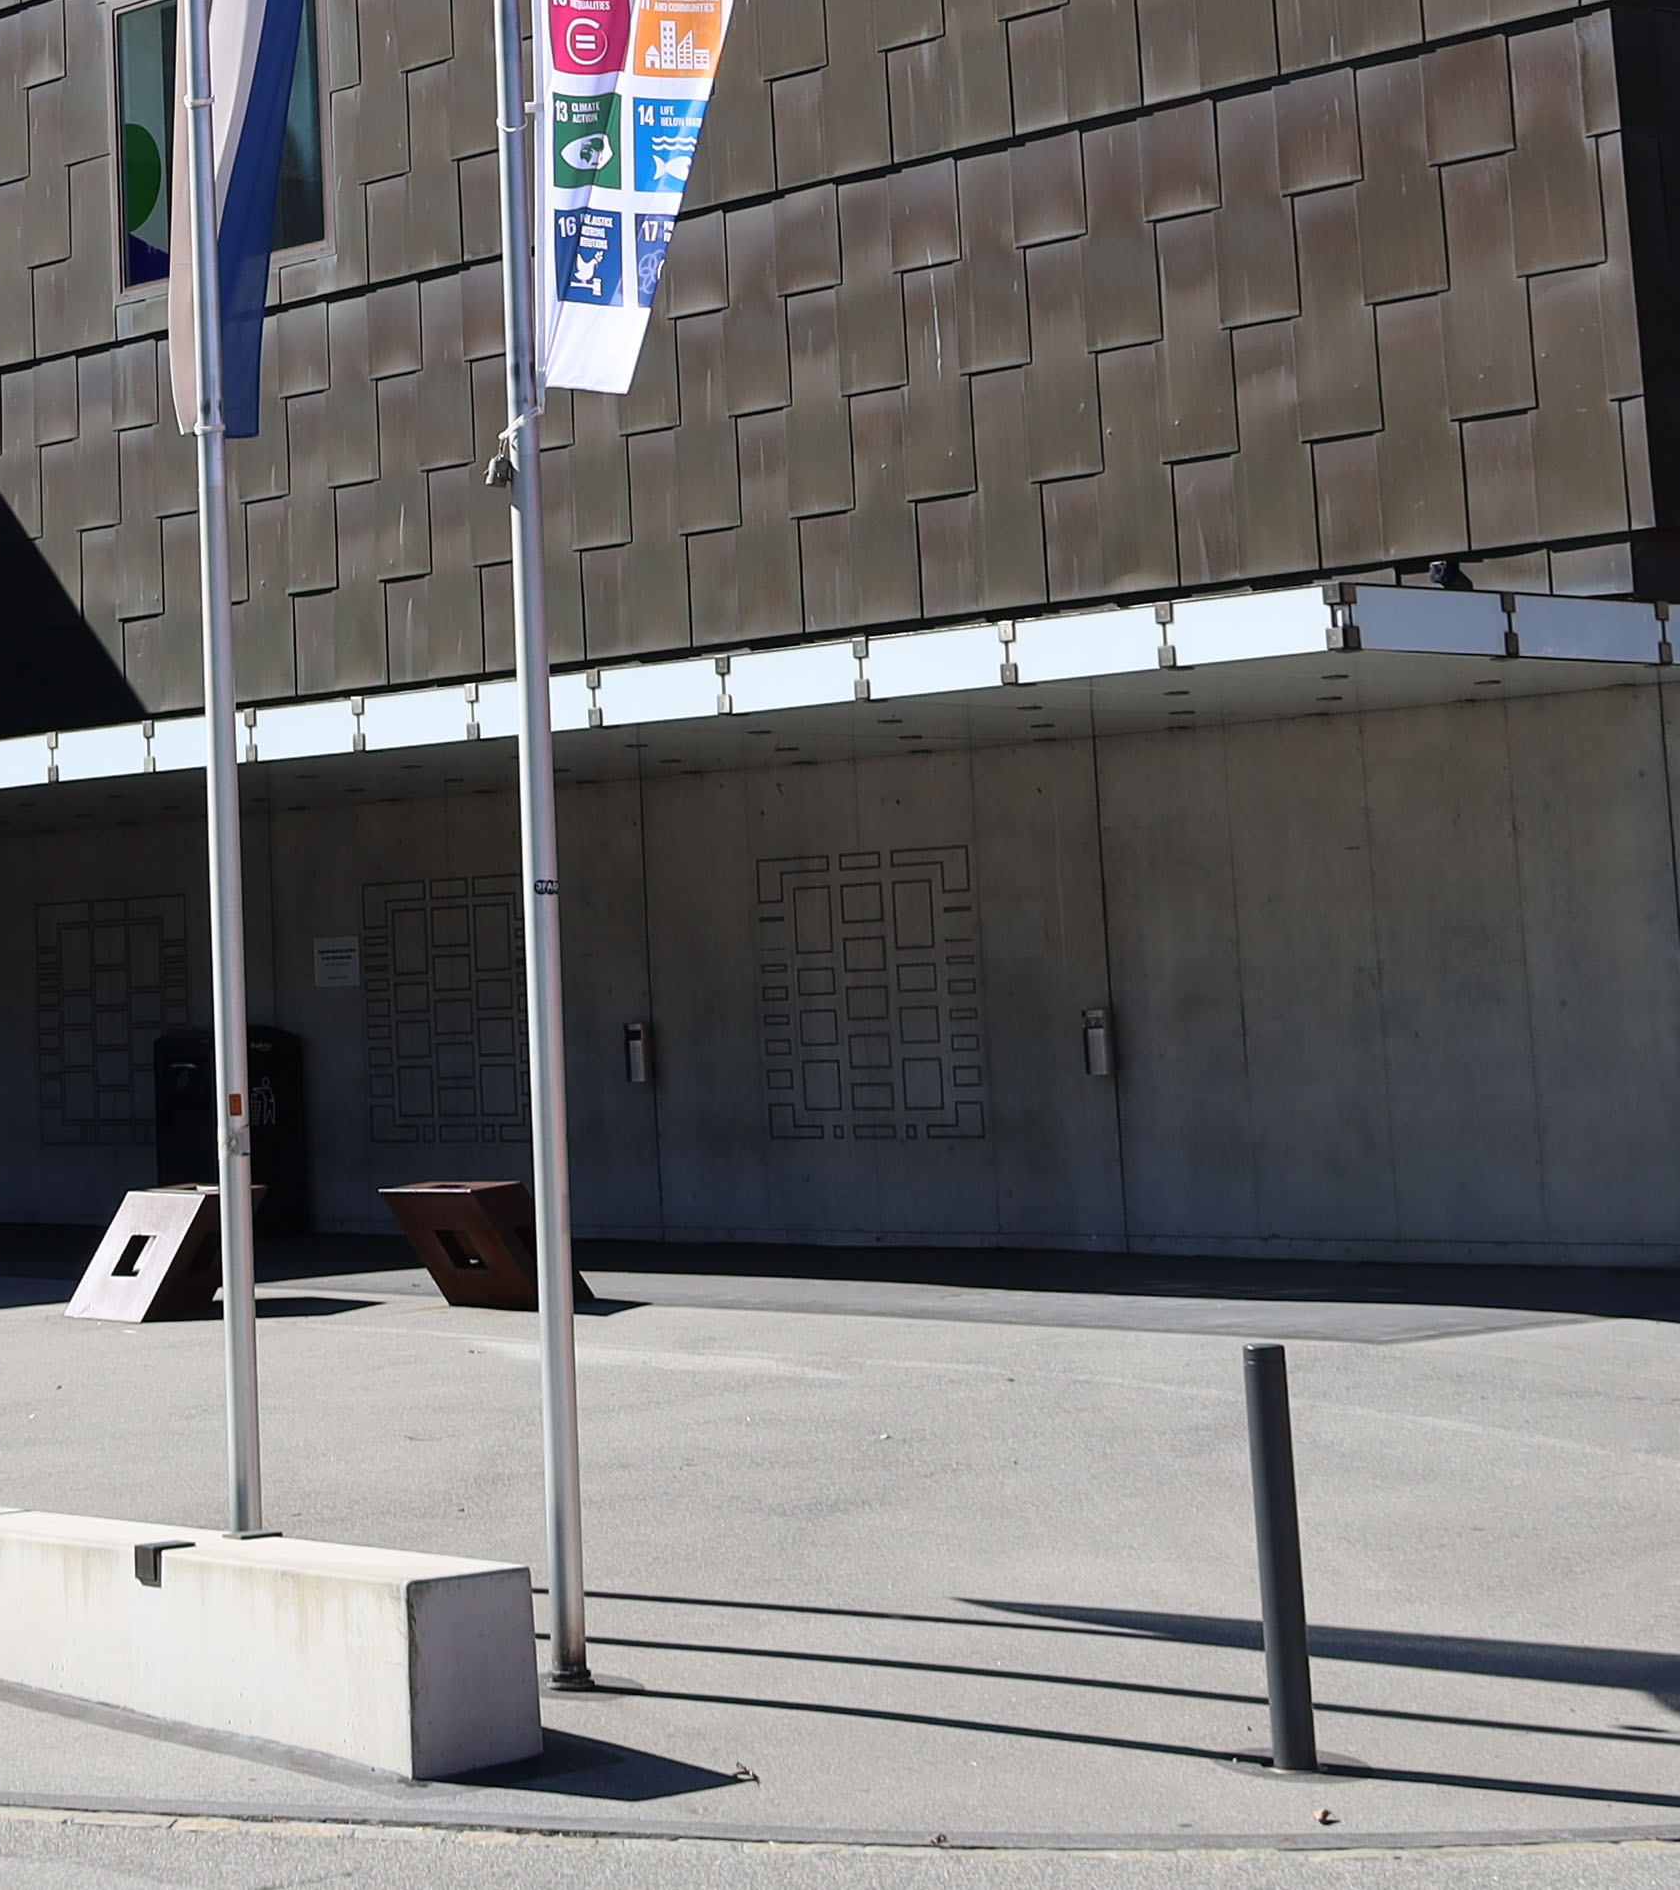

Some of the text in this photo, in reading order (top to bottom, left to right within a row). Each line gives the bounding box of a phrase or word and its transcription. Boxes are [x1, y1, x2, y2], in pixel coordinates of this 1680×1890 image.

[554, 100, 568, 122] 13
[638, 104, 675, 127] 14 LIFE
[557, 216, 577, 238] 16
[642, 220, 658, 242] 17
